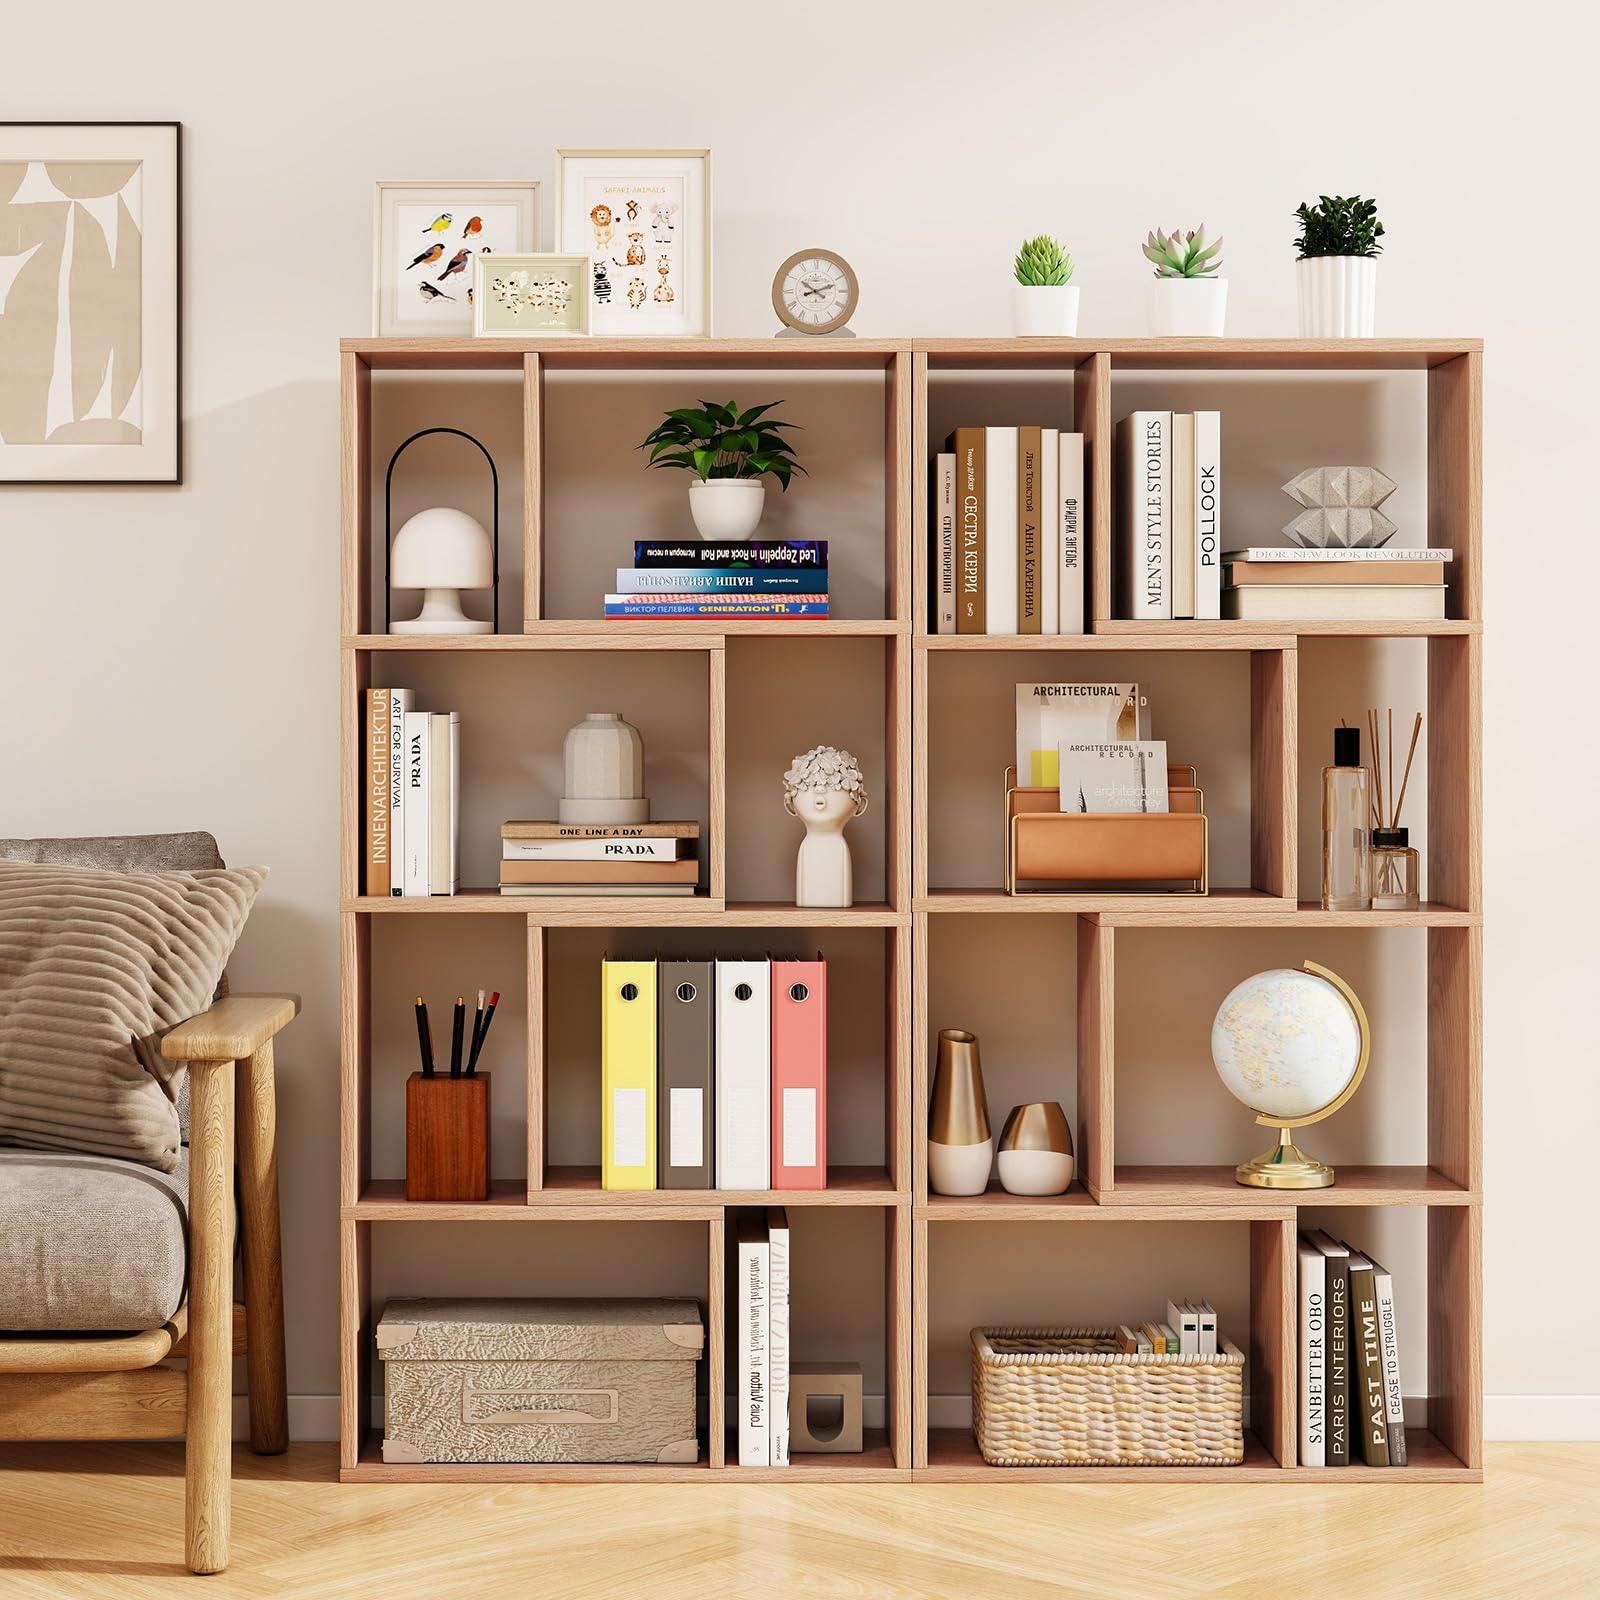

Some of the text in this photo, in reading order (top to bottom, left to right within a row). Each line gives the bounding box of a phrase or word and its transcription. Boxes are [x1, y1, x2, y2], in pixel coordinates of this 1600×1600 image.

[1147, 420, 1162, 493] STORIES
[964, 495, 978, 547] СЕСТРА
[1064, 498, 1078, 568] ФРИДРИХ ЭНГЕЛЬС
[1147, 496, 1162, 550] STYLE
[1201, 465, 1215, 566] POLLOCK
[636, 575, 754, 587] НАШИ АВИАНОСЦЫ
[701, 546, 816, 563] Led Zeppelin in Rock and Roll
[943, 515, 952, 594] СТИХОТВОРЕНИЯ
[964, 550, 978, 593] КЕРРИ
[1292, 551, 1323, 559] NEW
[1326, 551, 1361, 559] LOOK
[1365, 551, 1448, 559] REVOLUTION
[624, 605, 694, 613] ВИКТОР ПЕЛЕВИН
[1033, 686, 1121, 697] ARCHITECTURAL
[1073, 696, 1147, 706] REORD
[392, 697, 401, 809] ART FOR SURVIVAL
[411, 734, 421, 788] PRADA
[1070, 744, 1134, 752] ARCHITECTURAL
[373, 688, 387, 864] INNENARCHITEKTUR
[560, 828, 643, 836] ONE LINE A DAY
[604, 844, 655, 855] PRADA
[1308, 1293, 1322, 1444] SANBETTER OBO
[1333, 1277, 1344, 1454] PARIS INTERIORS
[1361, 1299, 1386, 1445] PAST TIME
[1381, 1298, 1402, 1415] CEASE TO STRUGGLE
